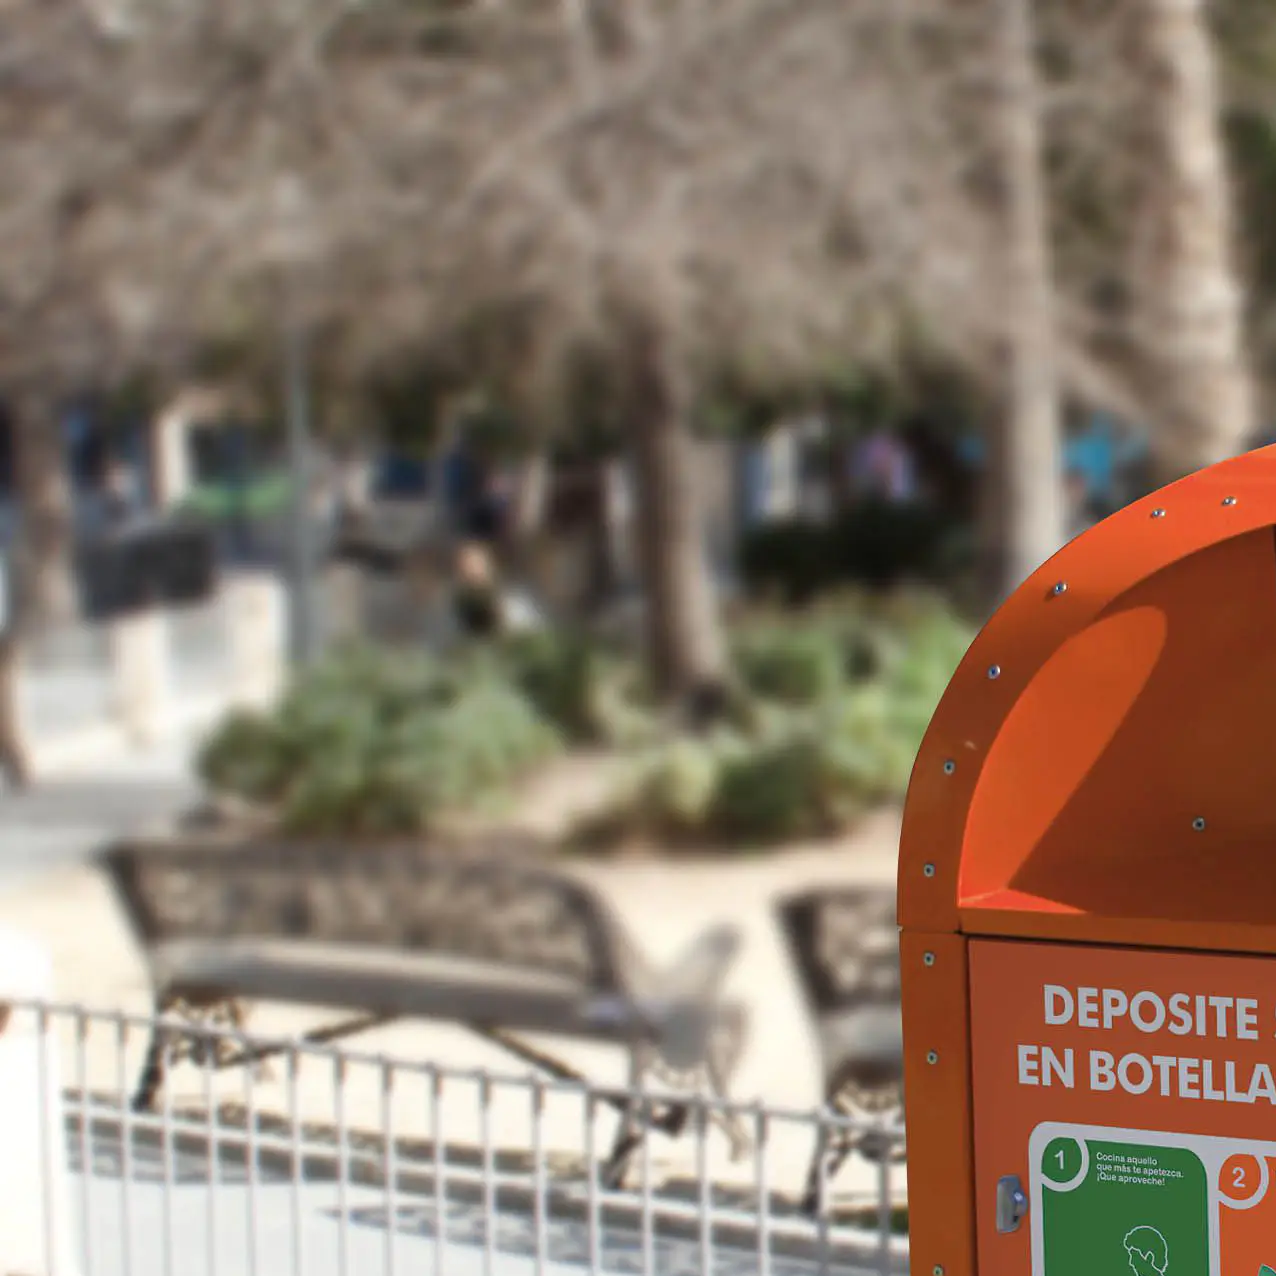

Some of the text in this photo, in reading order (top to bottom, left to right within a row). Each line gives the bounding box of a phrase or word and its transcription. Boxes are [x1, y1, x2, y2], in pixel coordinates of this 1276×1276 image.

[1043, 984, 1258, 1040] DEPOSITE
[1017, 1044, 1074, 1088] EN
[1054, 1150, 1064, 1170] 1
[1096, 1152, 1157, 1165] Cocina aquello
[1096, 1164, 1112, 1172] que
[1114, 1164, 1131, 1173] más
[1143, 1168, 1184, 1177] apetezca.
[1119, 1175, 1165, 1186] aproveche!
[1232, 1167, 1246, 1187] 2
